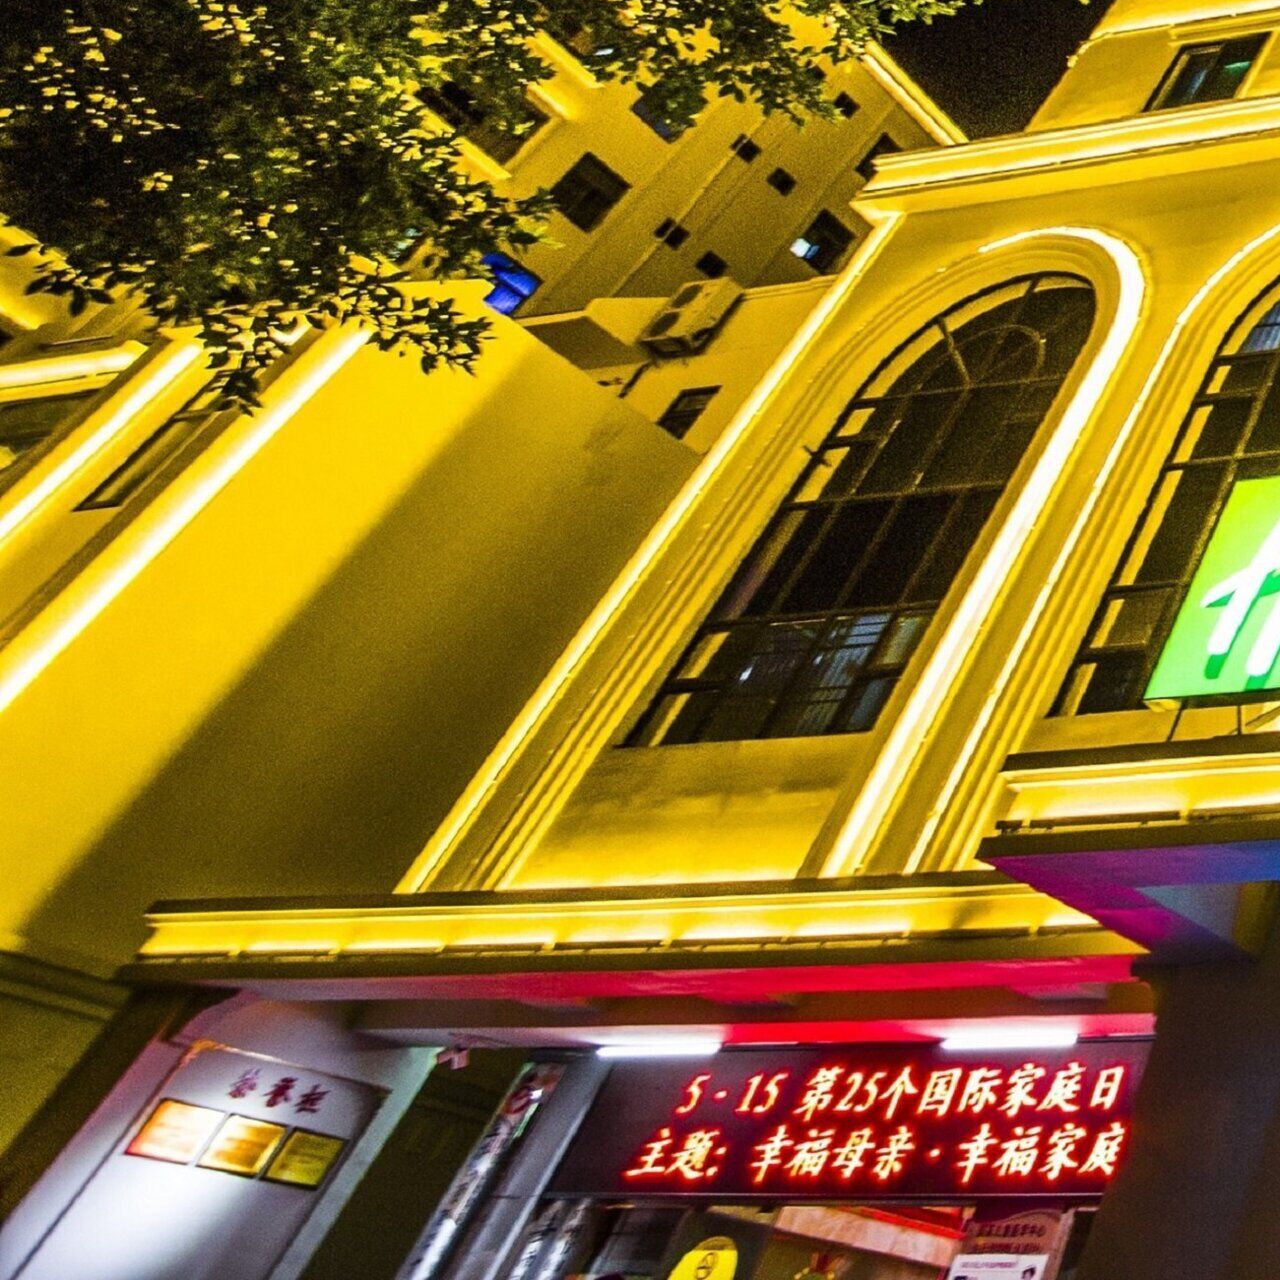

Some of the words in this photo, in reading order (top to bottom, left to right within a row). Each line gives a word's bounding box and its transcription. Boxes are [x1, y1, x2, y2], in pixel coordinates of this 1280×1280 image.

[793, 1061, 1126, 1122] 第25个国际家庭日
